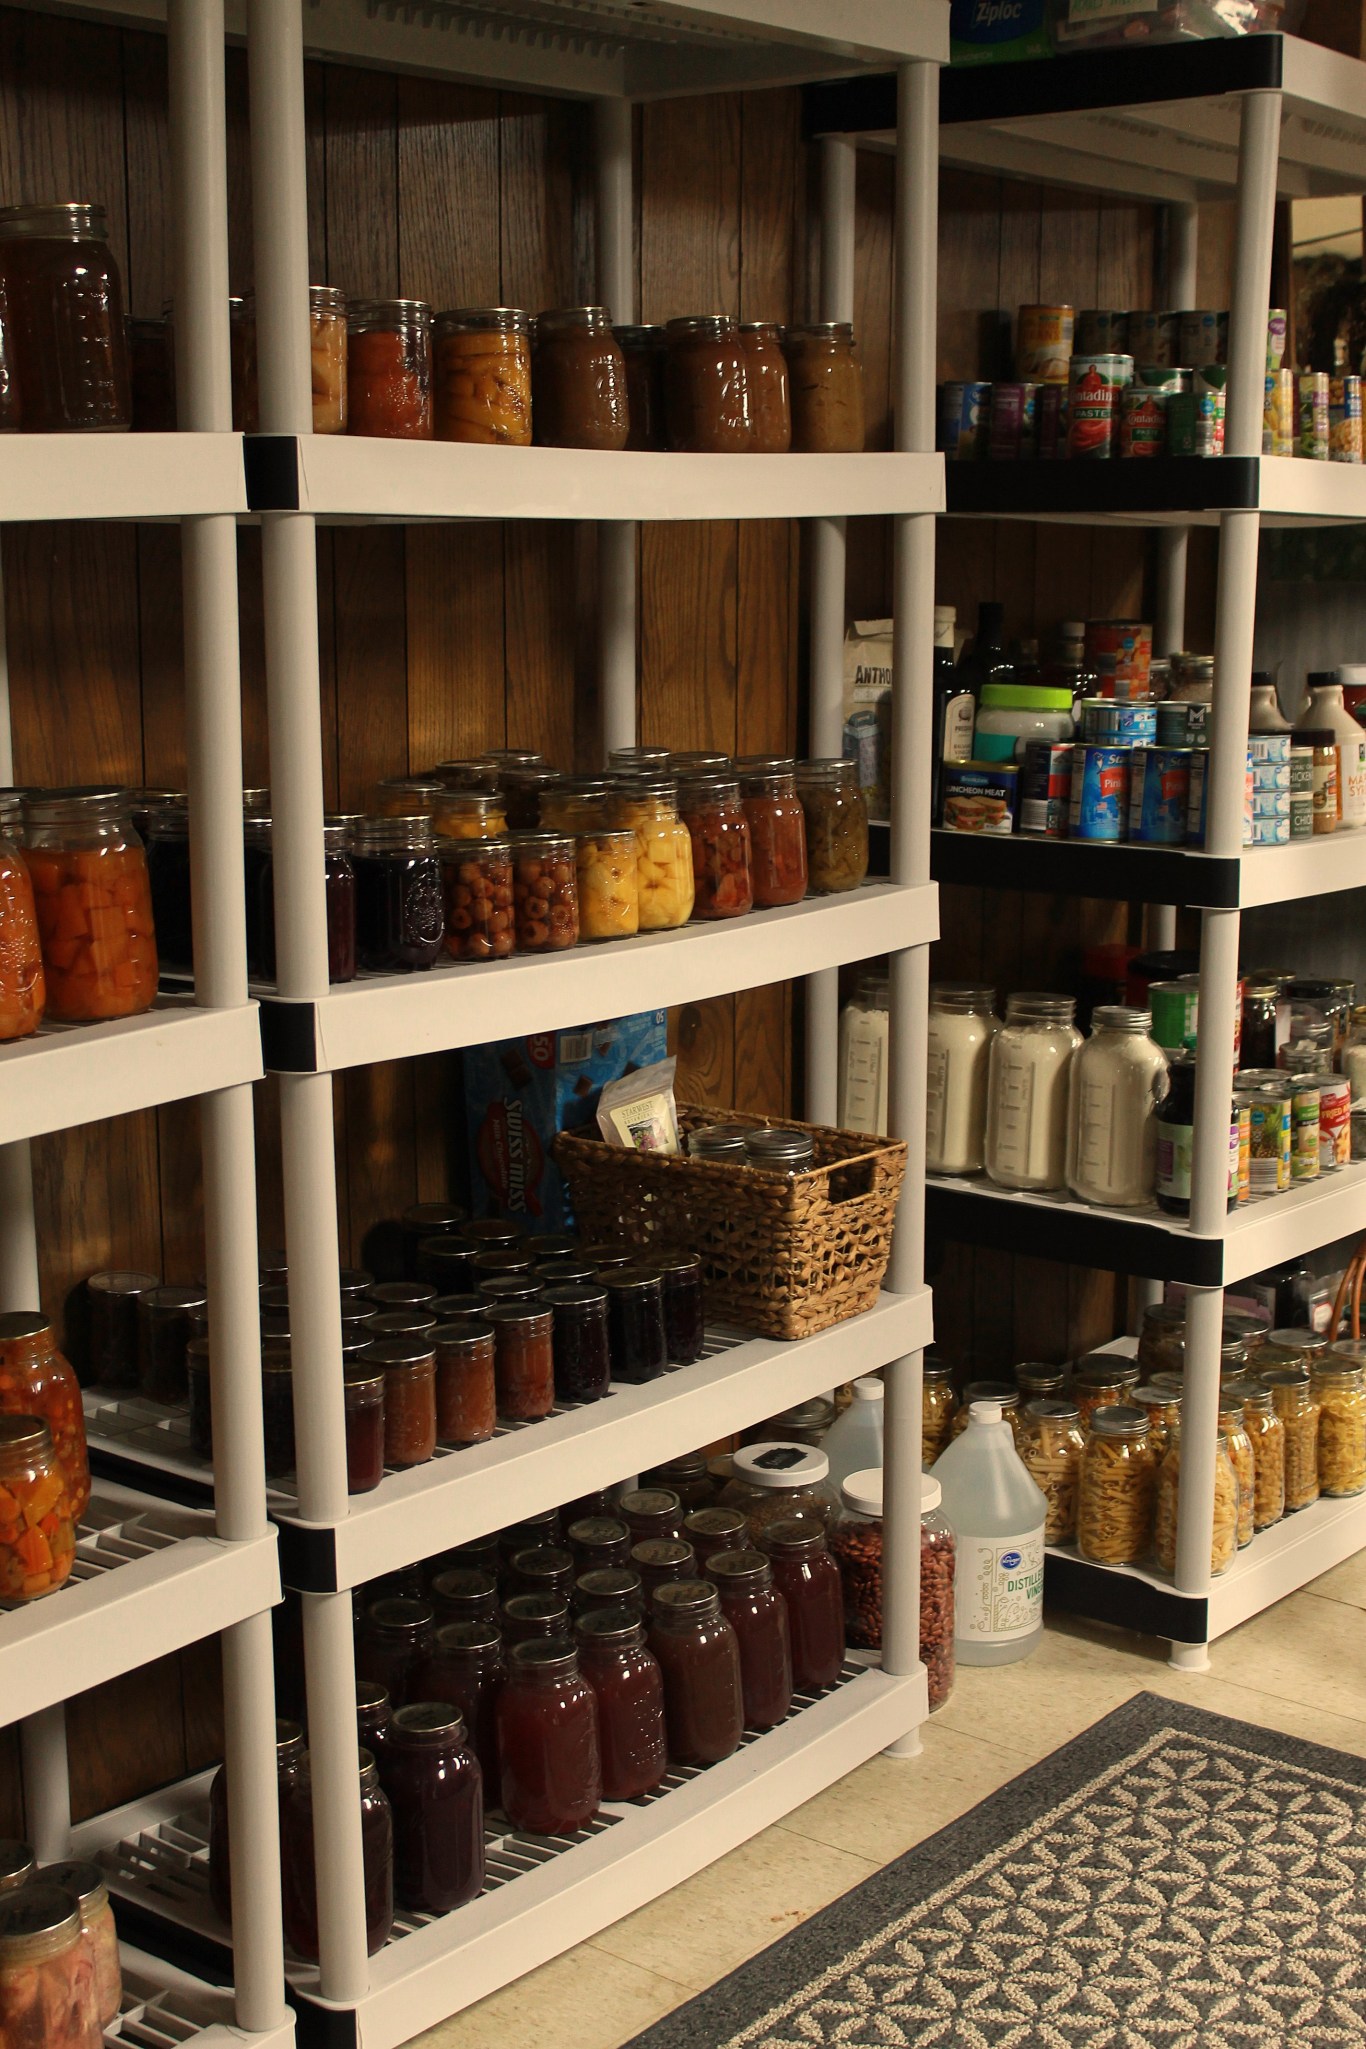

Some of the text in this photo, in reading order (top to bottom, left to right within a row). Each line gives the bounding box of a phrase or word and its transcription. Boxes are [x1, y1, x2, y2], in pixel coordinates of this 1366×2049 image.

[975, 2, 1022, 27] Ziploc
[1075, 409, 1108, 418] PASTE
[855, 664, 893, 684] ANTHO
[984, 788, 1007, 798] MEAT
[533, 1034, 550, 1062] 50
[622, 1101, 653, 1116] STARWEST
[504, 1097, 523, 1159] SWISS
[1026, 1582, 1043, 1600] VINE
